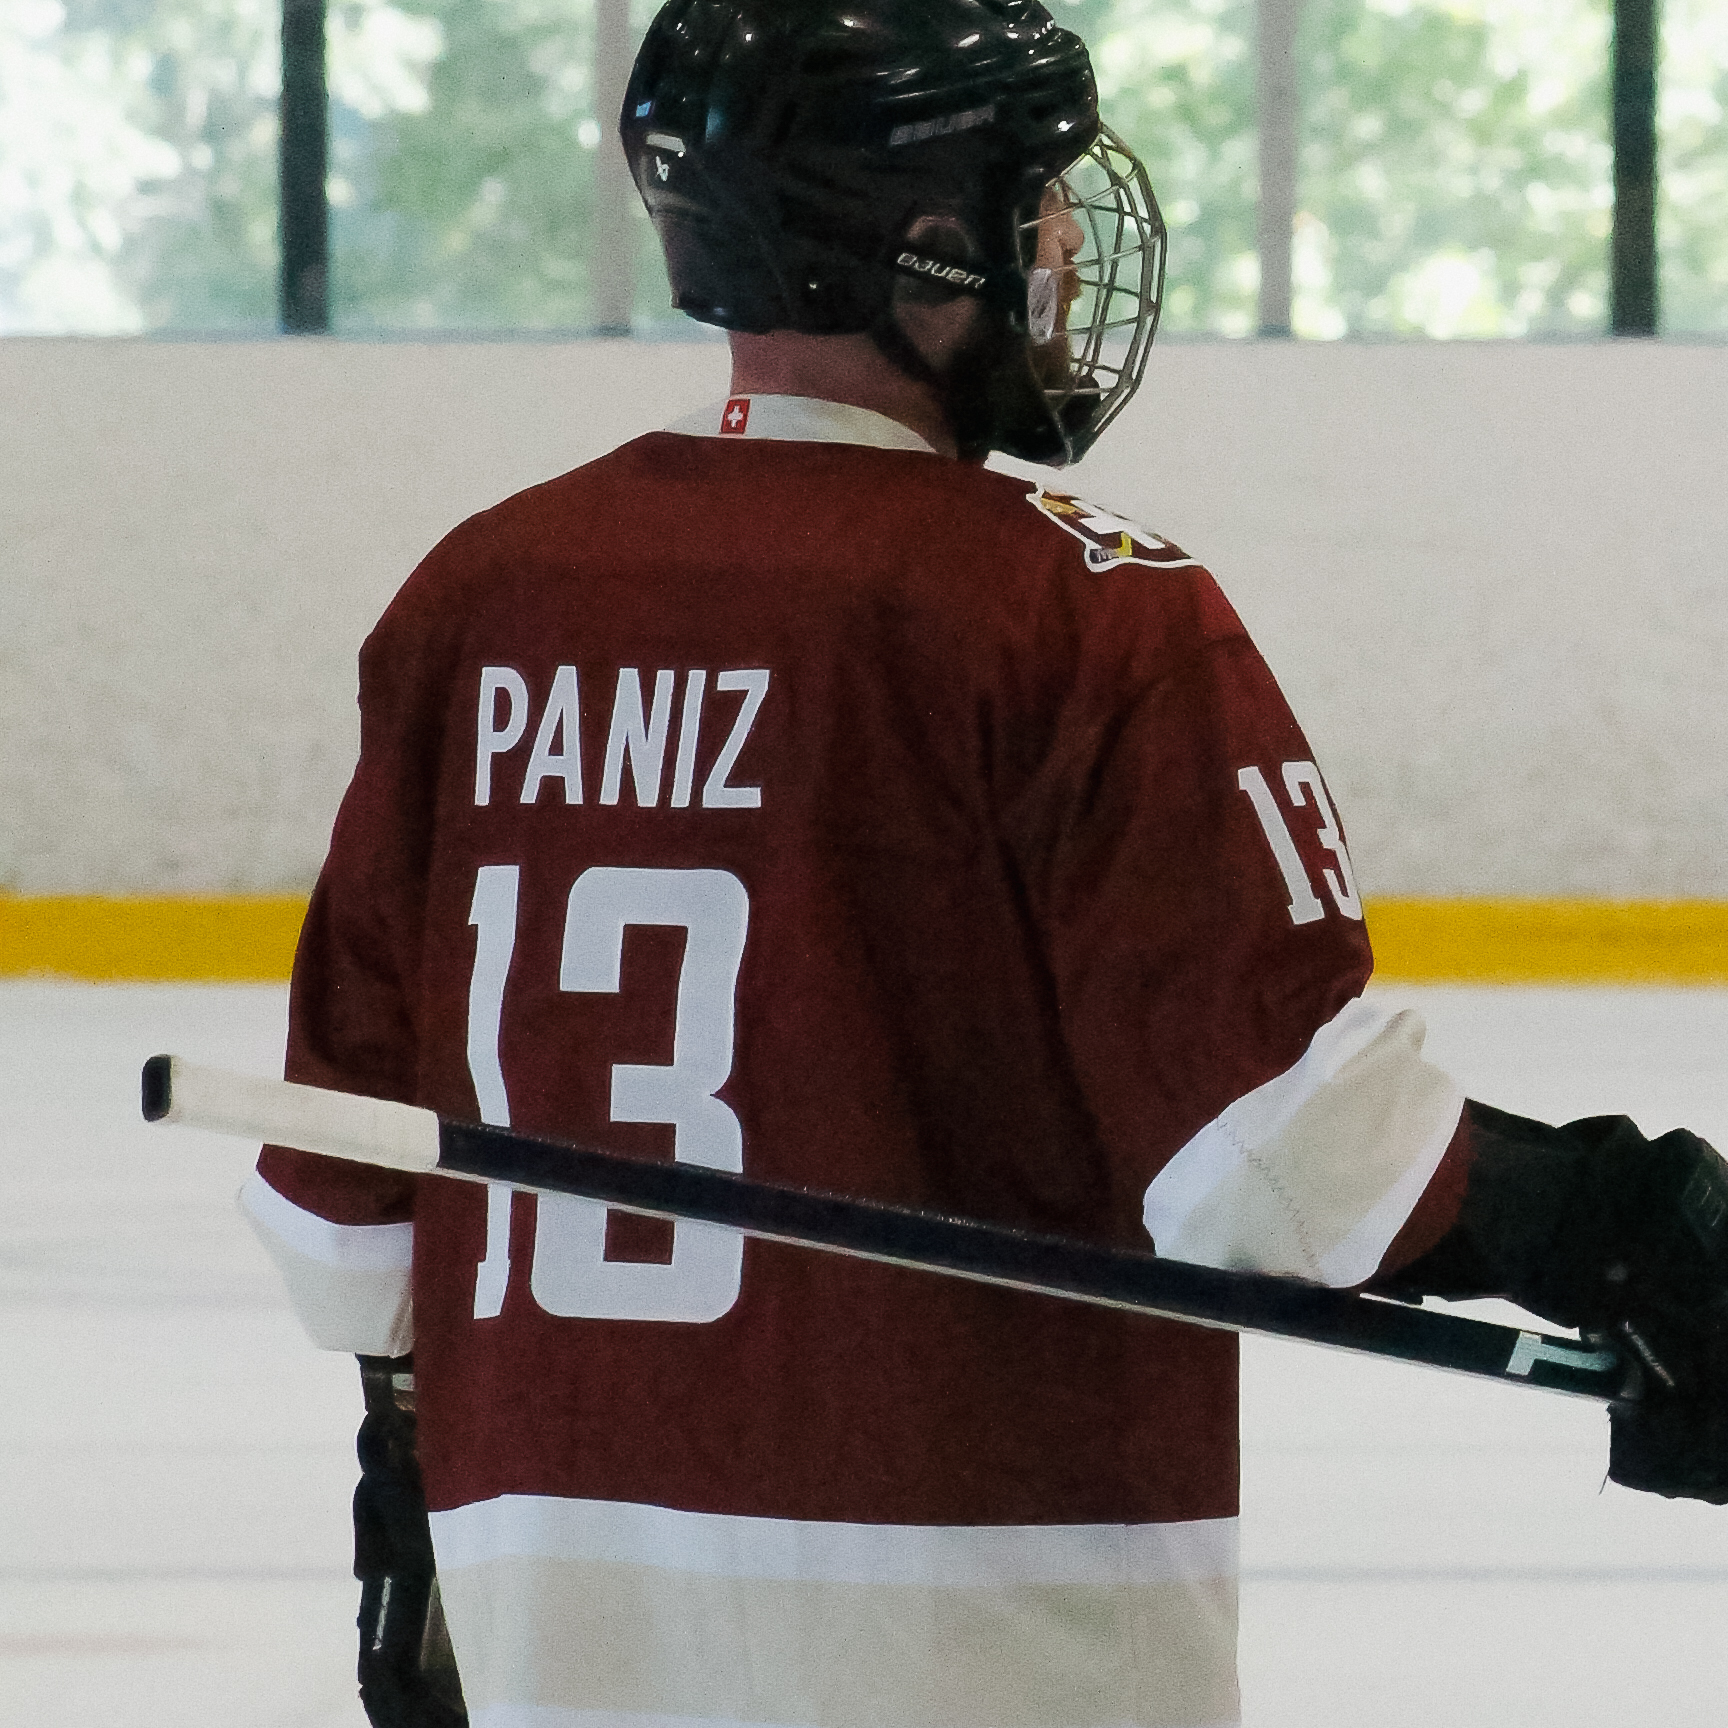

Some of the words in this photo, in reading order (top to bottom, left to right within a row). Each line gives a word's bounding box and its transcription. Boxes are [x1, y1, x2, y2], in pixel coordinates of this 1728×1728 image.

[475, 665, 770, 808] PANIZ
[1238, 760, 1363, 925] 13
[467, 864, 750, 1323] 13
